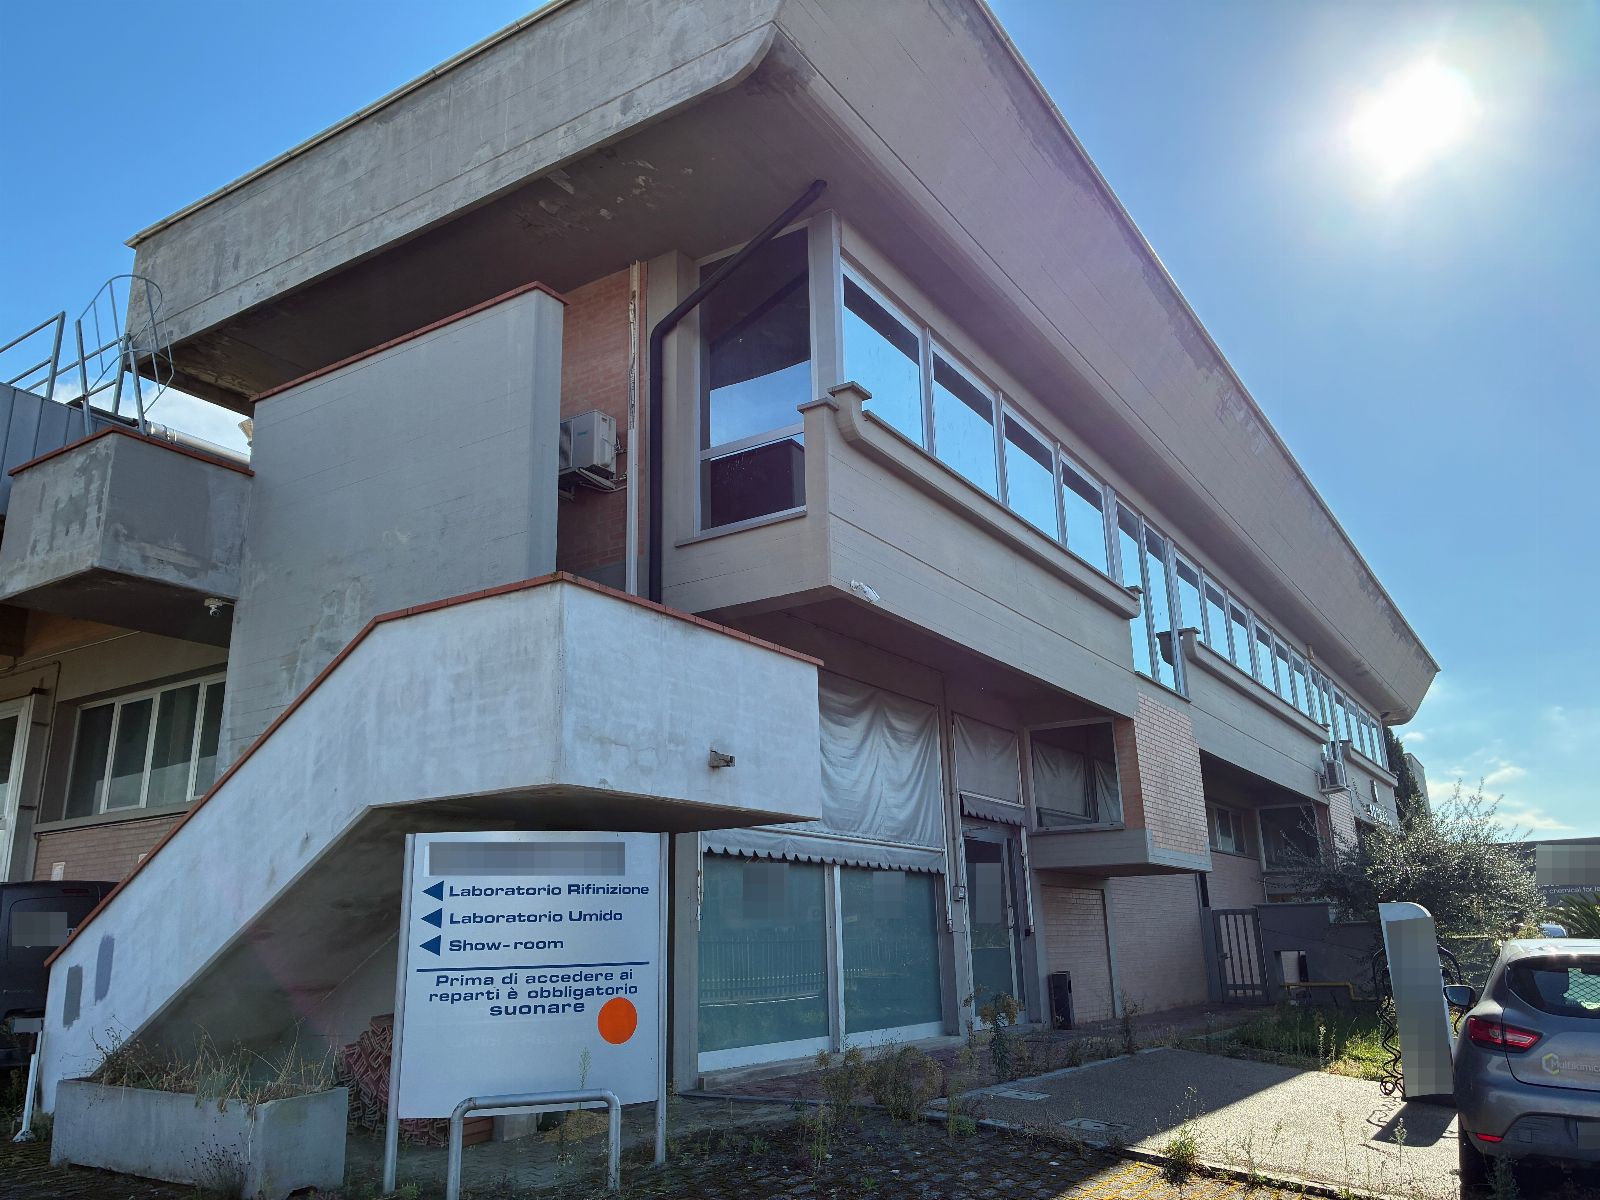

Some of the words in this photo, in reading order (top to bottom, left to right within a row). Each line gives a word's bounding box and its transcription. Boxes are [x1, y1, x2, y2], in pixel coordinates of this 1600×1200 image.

[448, 884, 562, 898] Laboratorio
[567, 883, 650, 896] Rifinizione
[449, 910, 564, 925] Laboratorio
[568, 909, 623, 922] Umido
[448, 939, 564, 952] Show-room
[435, 974, 495, 987] Prima
[501, 972, 518, 985] di
[525, 970, 614, 985] accedere
[619, 968, 633, 981] ai
[428, 988, 500, 1004] reparti
[507, 986, 519, 1000] è
[527, 983, 638, 1000] obbligatorio
[489, 1002, 585, 1017] suonare
